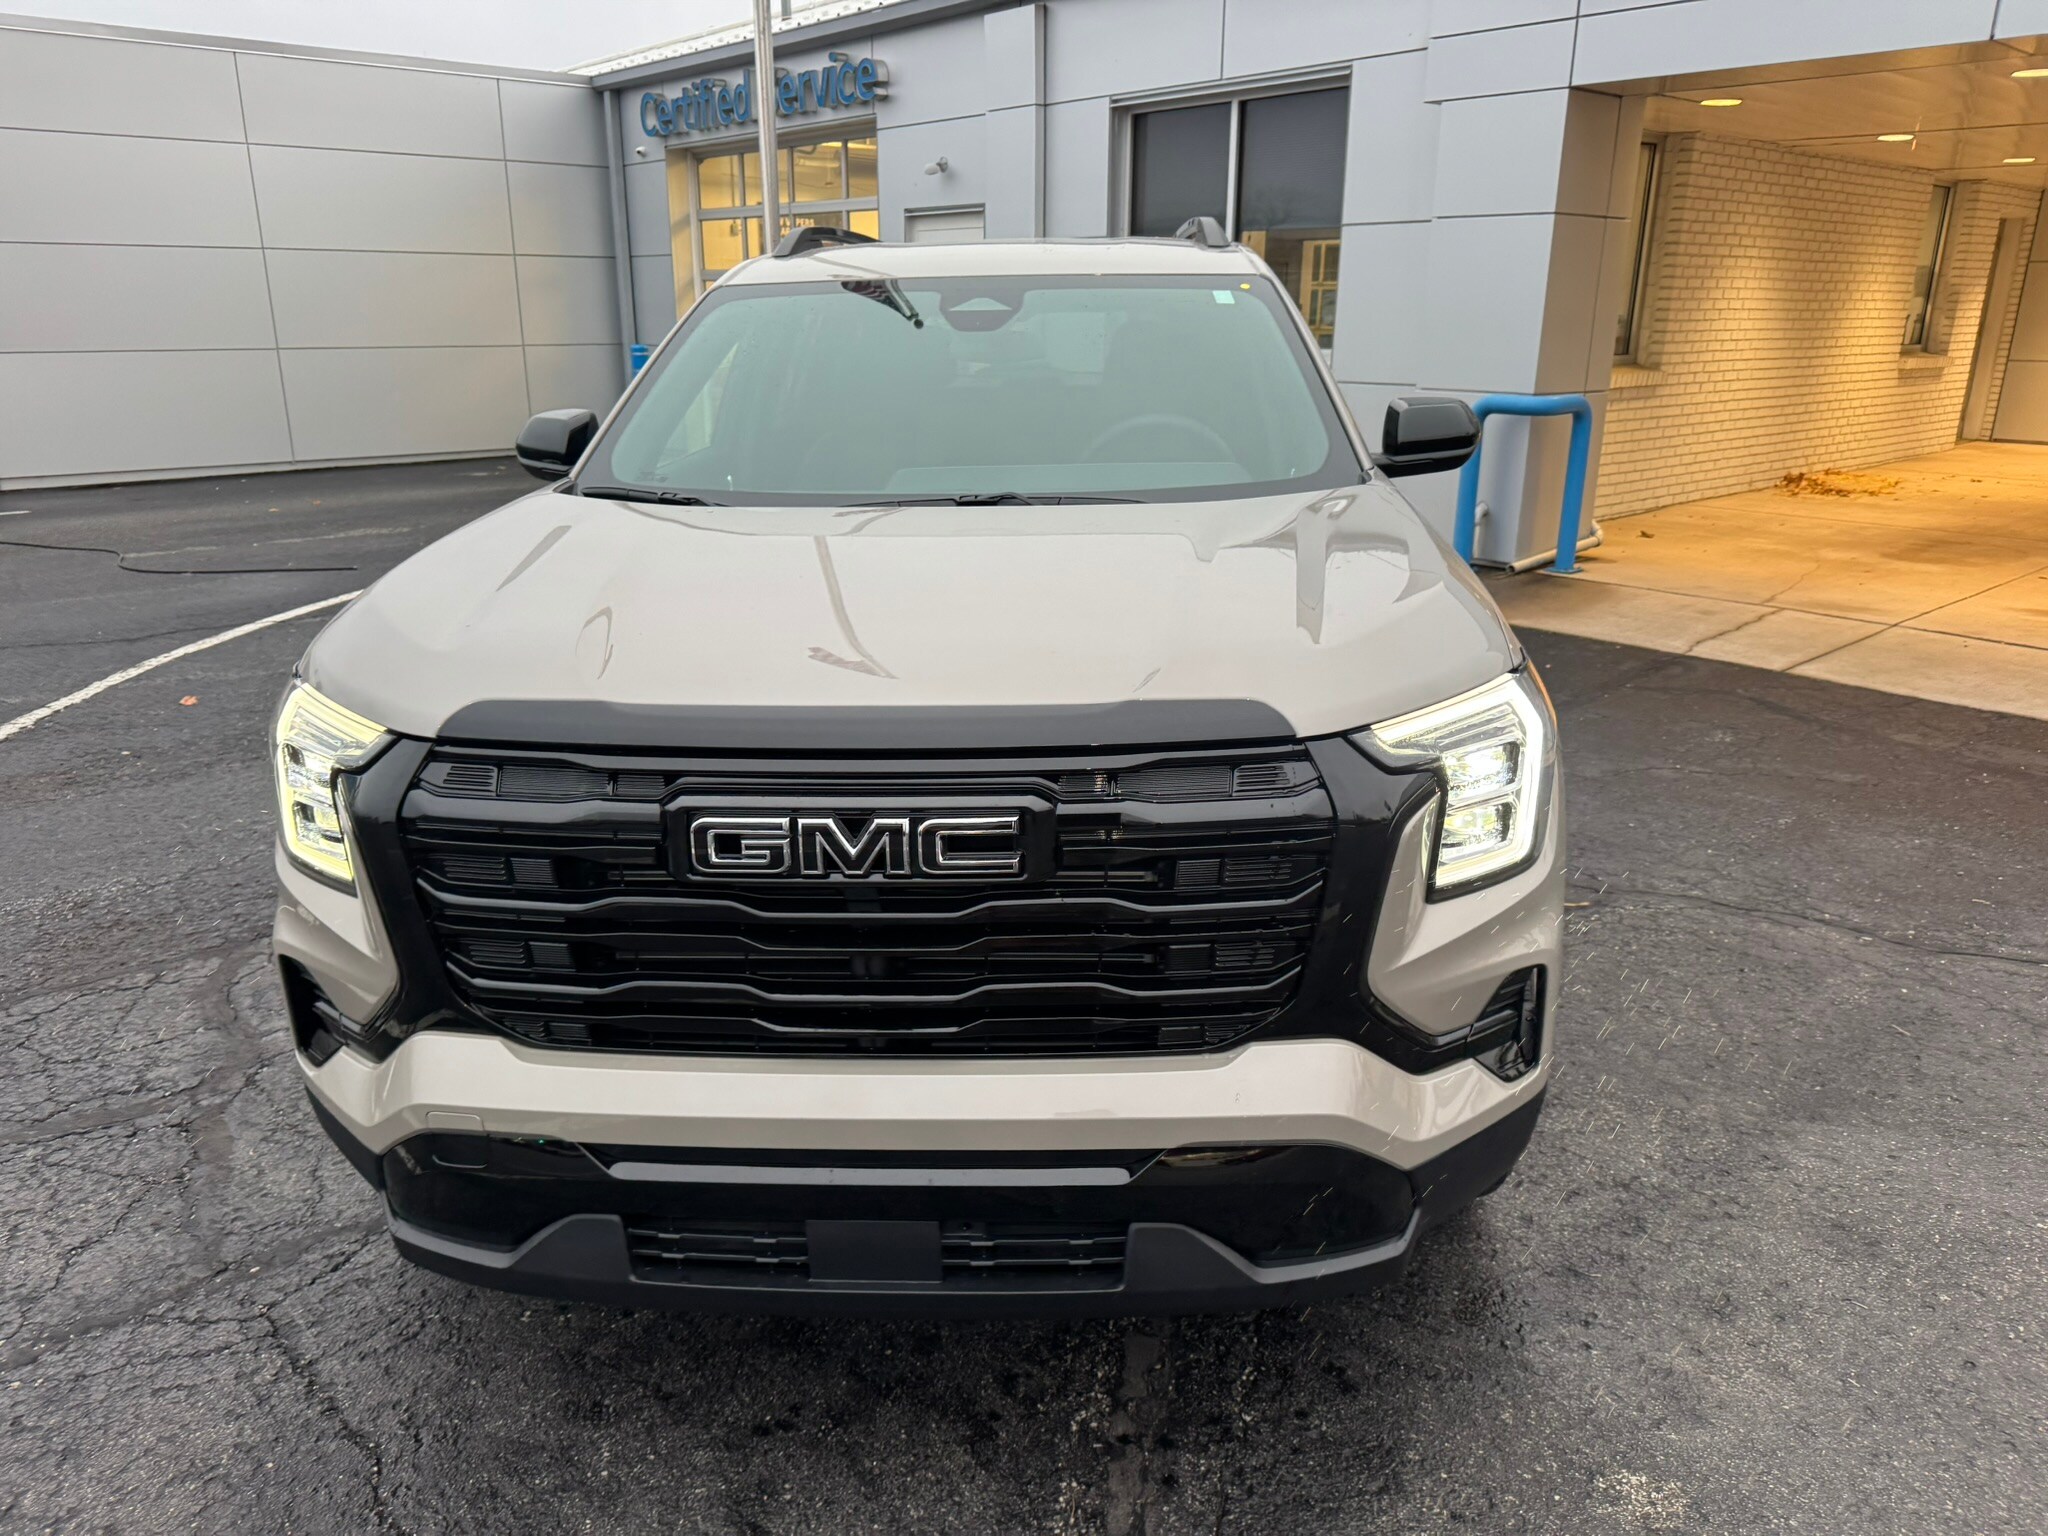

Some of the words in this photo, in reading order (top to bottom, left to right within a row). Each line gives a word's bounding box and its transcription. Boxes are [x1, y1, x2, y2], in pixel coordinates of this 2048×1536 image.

[641, 69, 752, 137] Certified
[773, 52, 880, 115] ervice
[691, 816, 1024, 875] GMC
